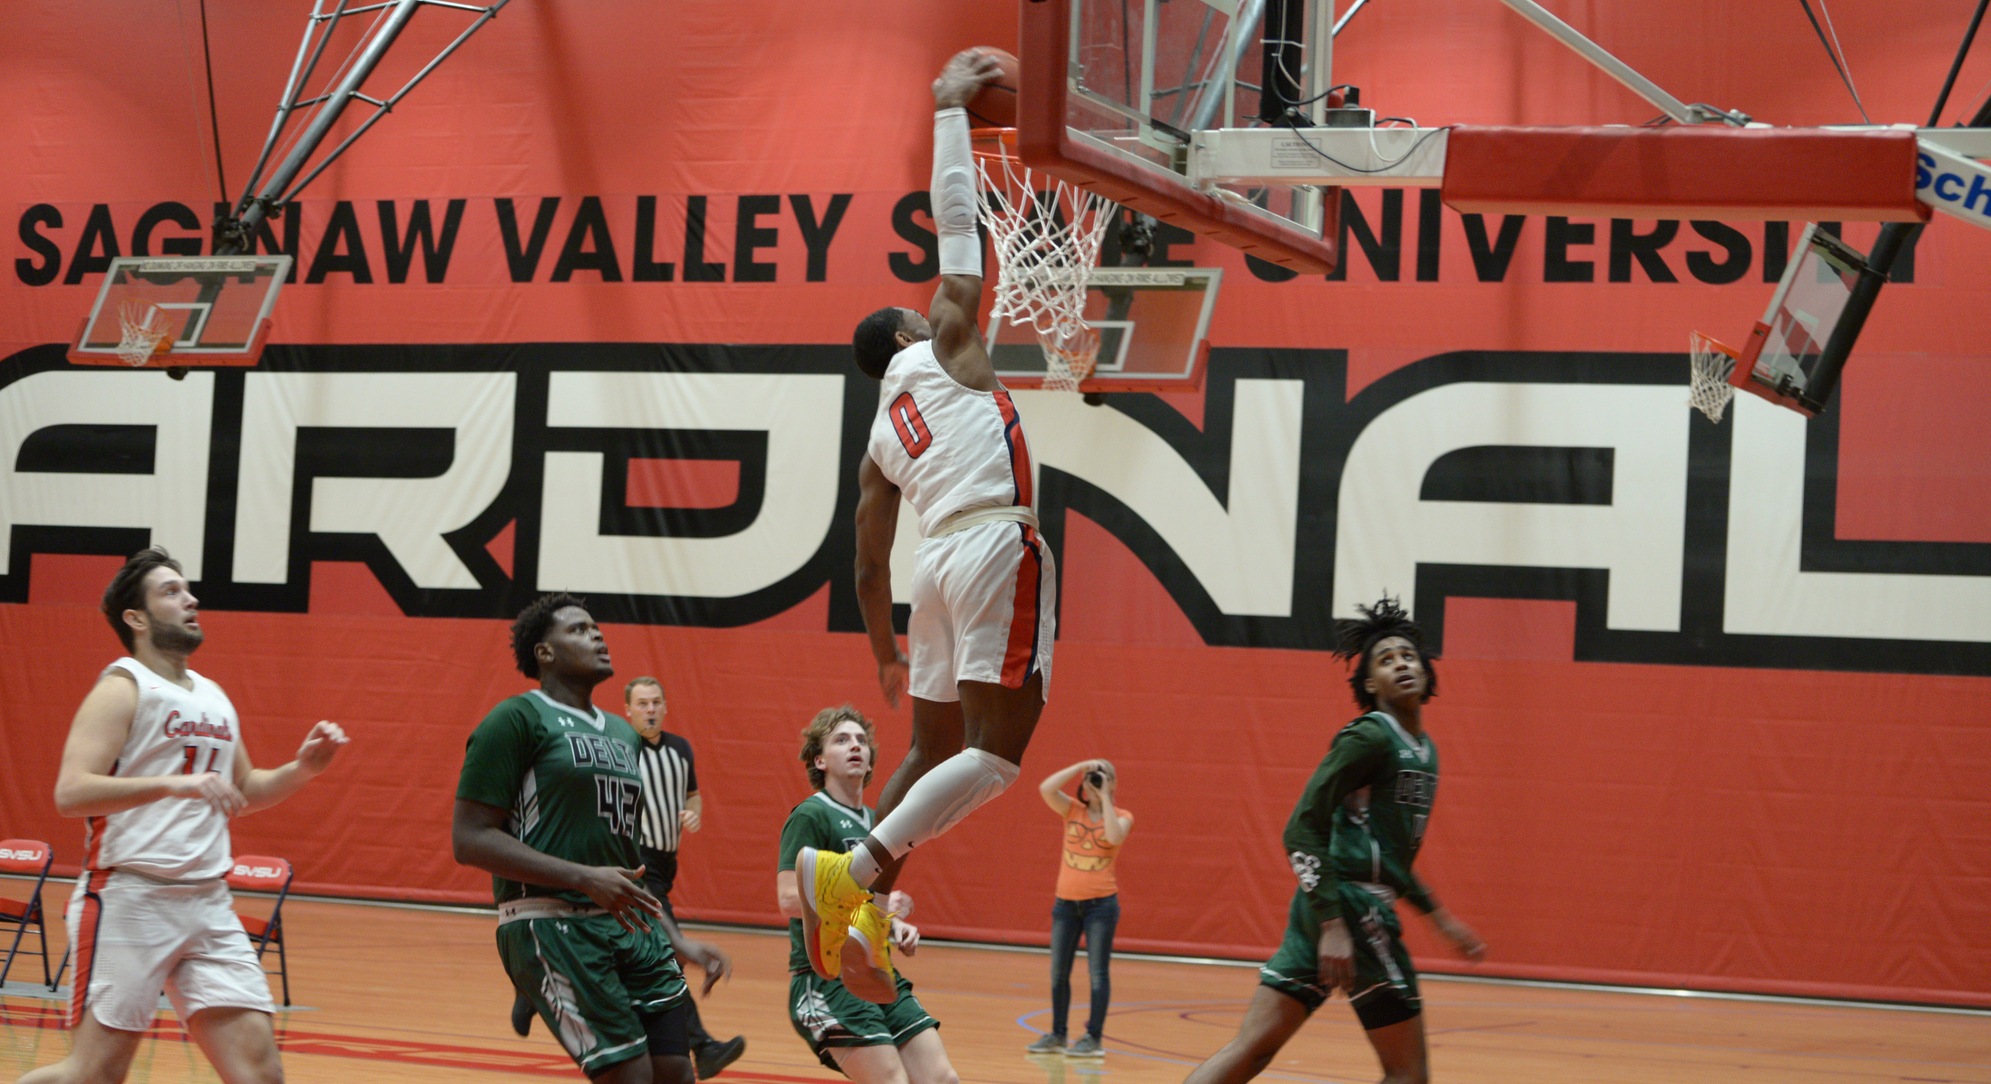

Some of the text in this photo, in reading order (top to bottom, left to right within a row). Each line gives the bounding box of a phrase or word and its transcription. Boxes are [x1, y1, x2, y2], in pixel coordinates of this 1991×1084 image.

[1916, 152, 1991, 217] Sch
[494, 194, 853, 283] VALLEY
[889, 391, 933, 459] 0
[0, 362, 1991, 652] ARDNAL
[564, 731, 640, 775] DELT
[594, 774, 642, 839] 42
[0, 848, 43, 861] SVSU
[233, 864, 282, 878] SVSU
